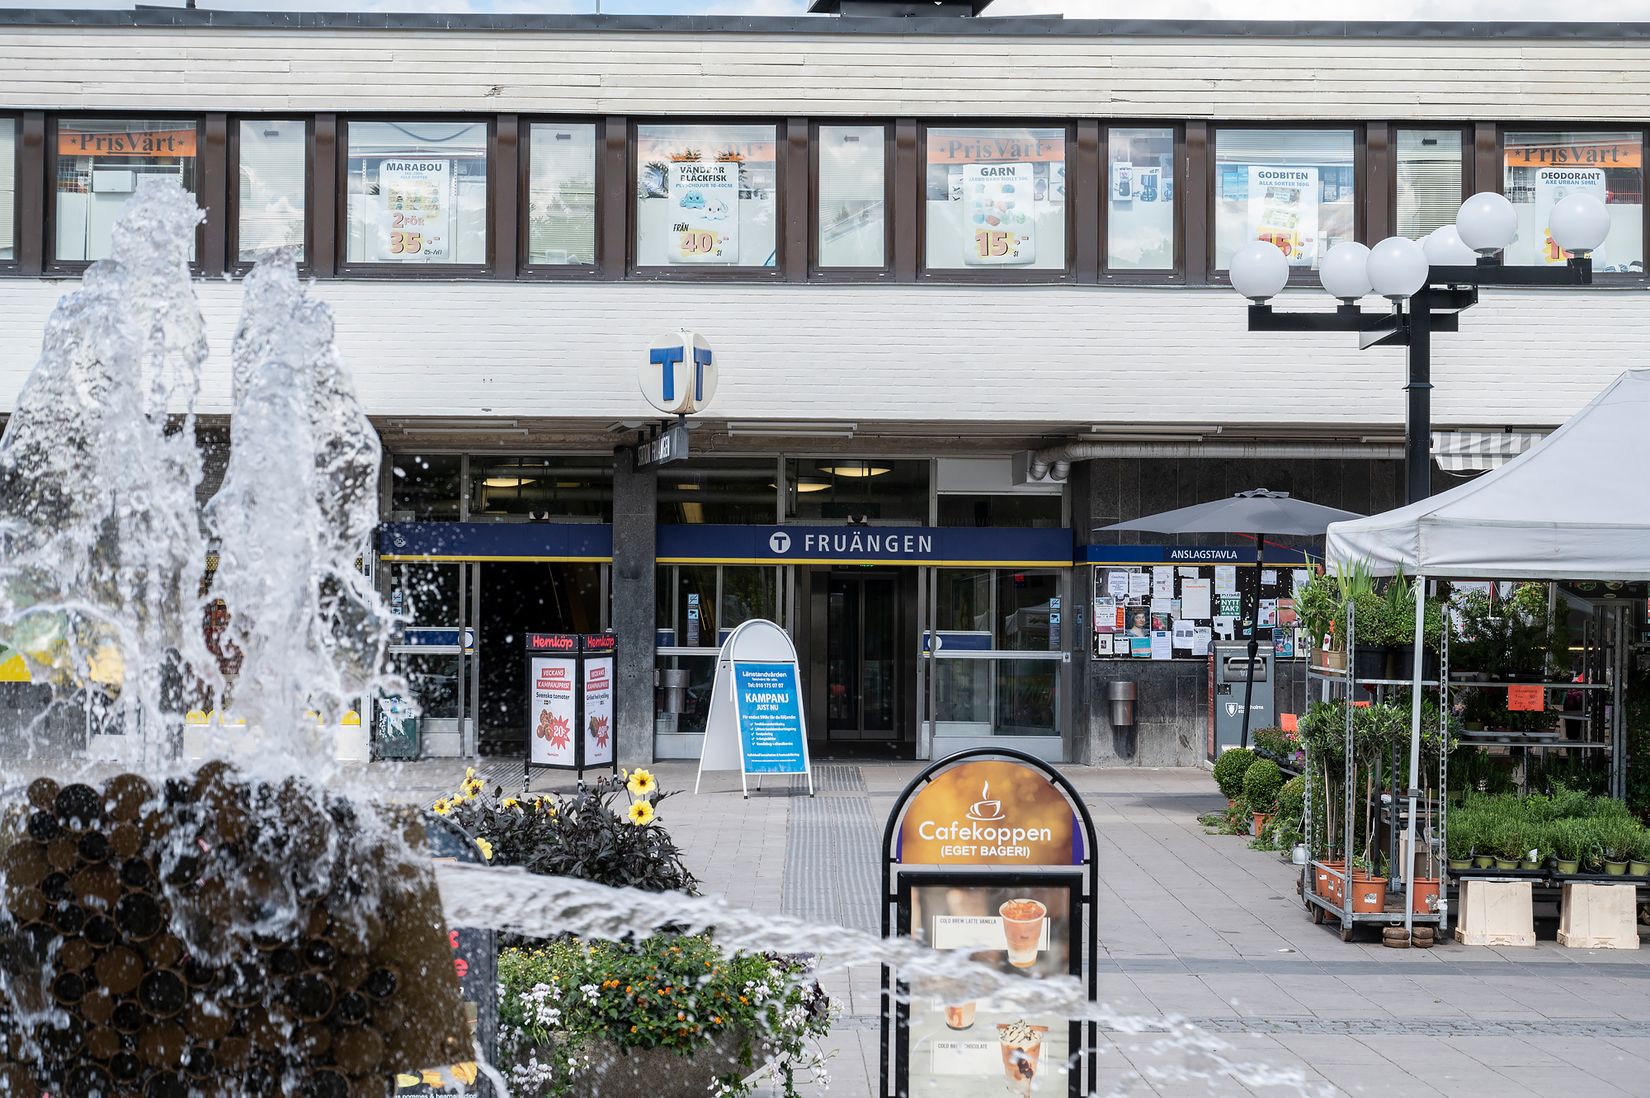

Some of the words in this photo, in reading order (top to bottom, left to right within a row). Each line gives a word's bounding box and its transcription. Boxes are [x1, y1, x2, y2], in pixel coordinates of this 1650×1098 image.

[79, 131, 176, 152] PrisVärt
[1523, 146, 1620, 163] PrisVärt
[386, 163, 442, 172] MARABOU
[980, 167, 1016, 176] GARN
[680, 173, 727, 182] BLÄCKFISK
[1258, 171, 1309, 180] GODBITEN
[1541, 172, 1601, 180] DEODORANT
[392, 212, 405, 229] 2
[650, 346, 684, 401] T
[805, 531, 932, 553] FRUÄNGEN
[1170, 549, 1238, 559] ANSLAGSTAVLA
[532, 634, 573, 650] Hemköp
[587, 634, 615, 649] Hemköp
[745, 693, 789, 703] KAMPANJ
[919, 821, 1052, 846] Cafekoppen
[940, 845, 978, 858] (EGET
[980, 846, 1031, 858] BAGERI)
